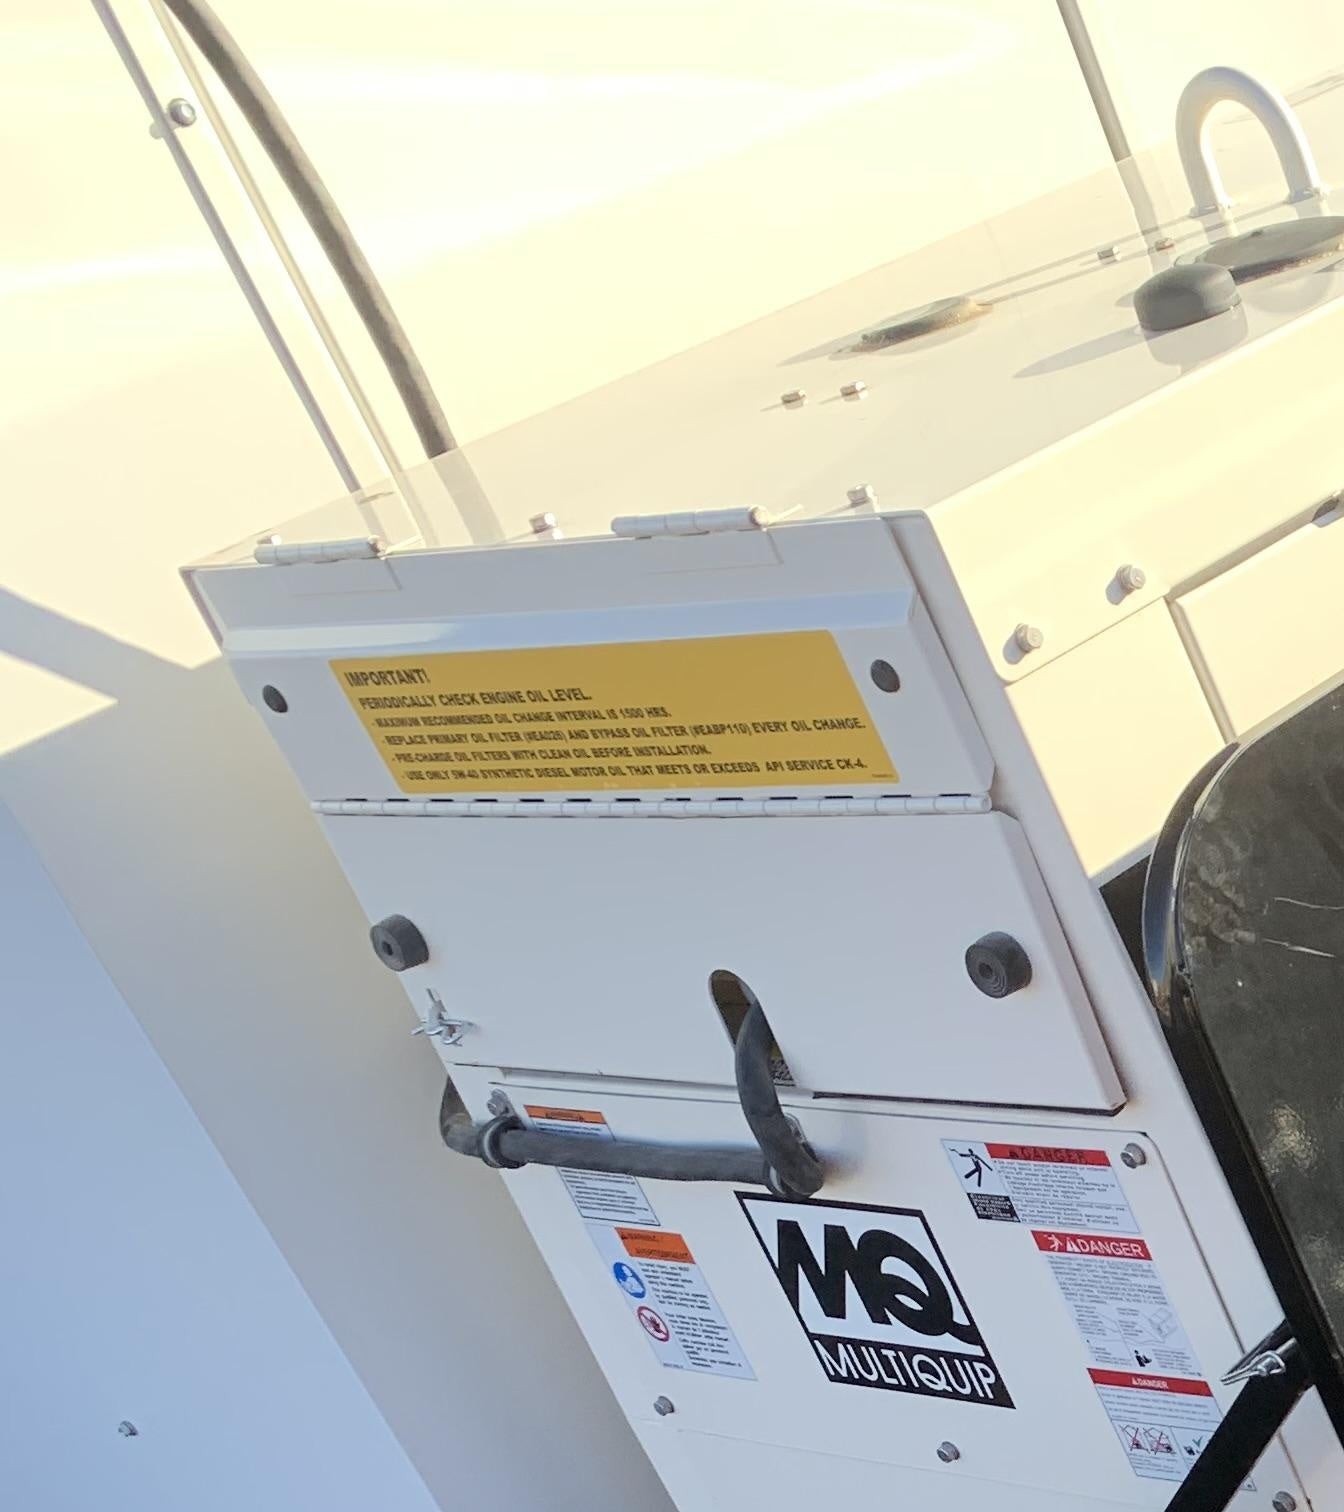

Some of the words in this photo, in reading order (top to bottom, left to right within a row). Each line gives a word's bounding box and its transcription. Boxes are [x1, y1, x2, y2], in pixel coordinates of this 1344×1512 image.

[345, 669, 430, 687] IMPORTANT!
[359, 695, 438, 709] PERIODICALLY
[438, 693, 479, 706] CHECK
[479, 691, 525, 704] ENGINE
[526, 690, 548, 702] OIL
[549, 688, 591, 701] LEVEL.
[376, 717, 422, 728] MAXIMUM
[421, 714, 493, 727] RECOMMENDED
[494, 713, 512, 724] OIL
[512, 712, 554, 723] CHANGE
[555, 709, 605, 721] INTERVAL
[606, 709, 618, 719] IS
[645, 707, 671, 718] HRS.
[386, 735, 428, 746] REPLACE
[428, 734, 470, 745] PRIMARY
[471, 733, 488, 743] OIL
[488, 731, 523, 742] FILTER
[567, 729, 590, 740] AND
[590, 727, 630, 739] BYPASS
[631, 727, 649, 737] OIL
[651, 725, 688, 737] FILTER
[752, 721, 788, 733] EVERY
[790, 720, 811, 731] OIL
[812, 718, 865, 731] CHANGE.
[454, 752, 471, 762] OIL
[472, 751, 511, 761] FILTERS
[511, 750, 537, 760] WITH
[538, 748, 572, 759] CLEAN
[572, 748, 591, 758] OIL
[591, 746, 632, 757] BEFORE
[632, 744, 711, 756] INSTALLATION.
[406, 772, 425, 781] USE
[425, 771, 452, 781] ONLY
[480, 769, 534, 779] SYNTHETIC
[535, 768, 569, 778] DIESEL
[571, 766, 607, 777] MOTOR
[608, 766, 626, 776] OIL
[627, 765, 654, 775] THAT
[655, 764, 691, 774] MEETS
[693, 763, 709, 773] OR
[710, 762, 760, 773] EXCEEDS
[765, 761, 784, 771] API
[786, 759, 834, 770] SERVICE
[836, 758, 866, 769] CK-4.
[1078, 1239, 1145, 1257] DANGER
[776, 1219, 982, 1345] MQ
[813, 1339, 996, 1399] MULTIQUIP
